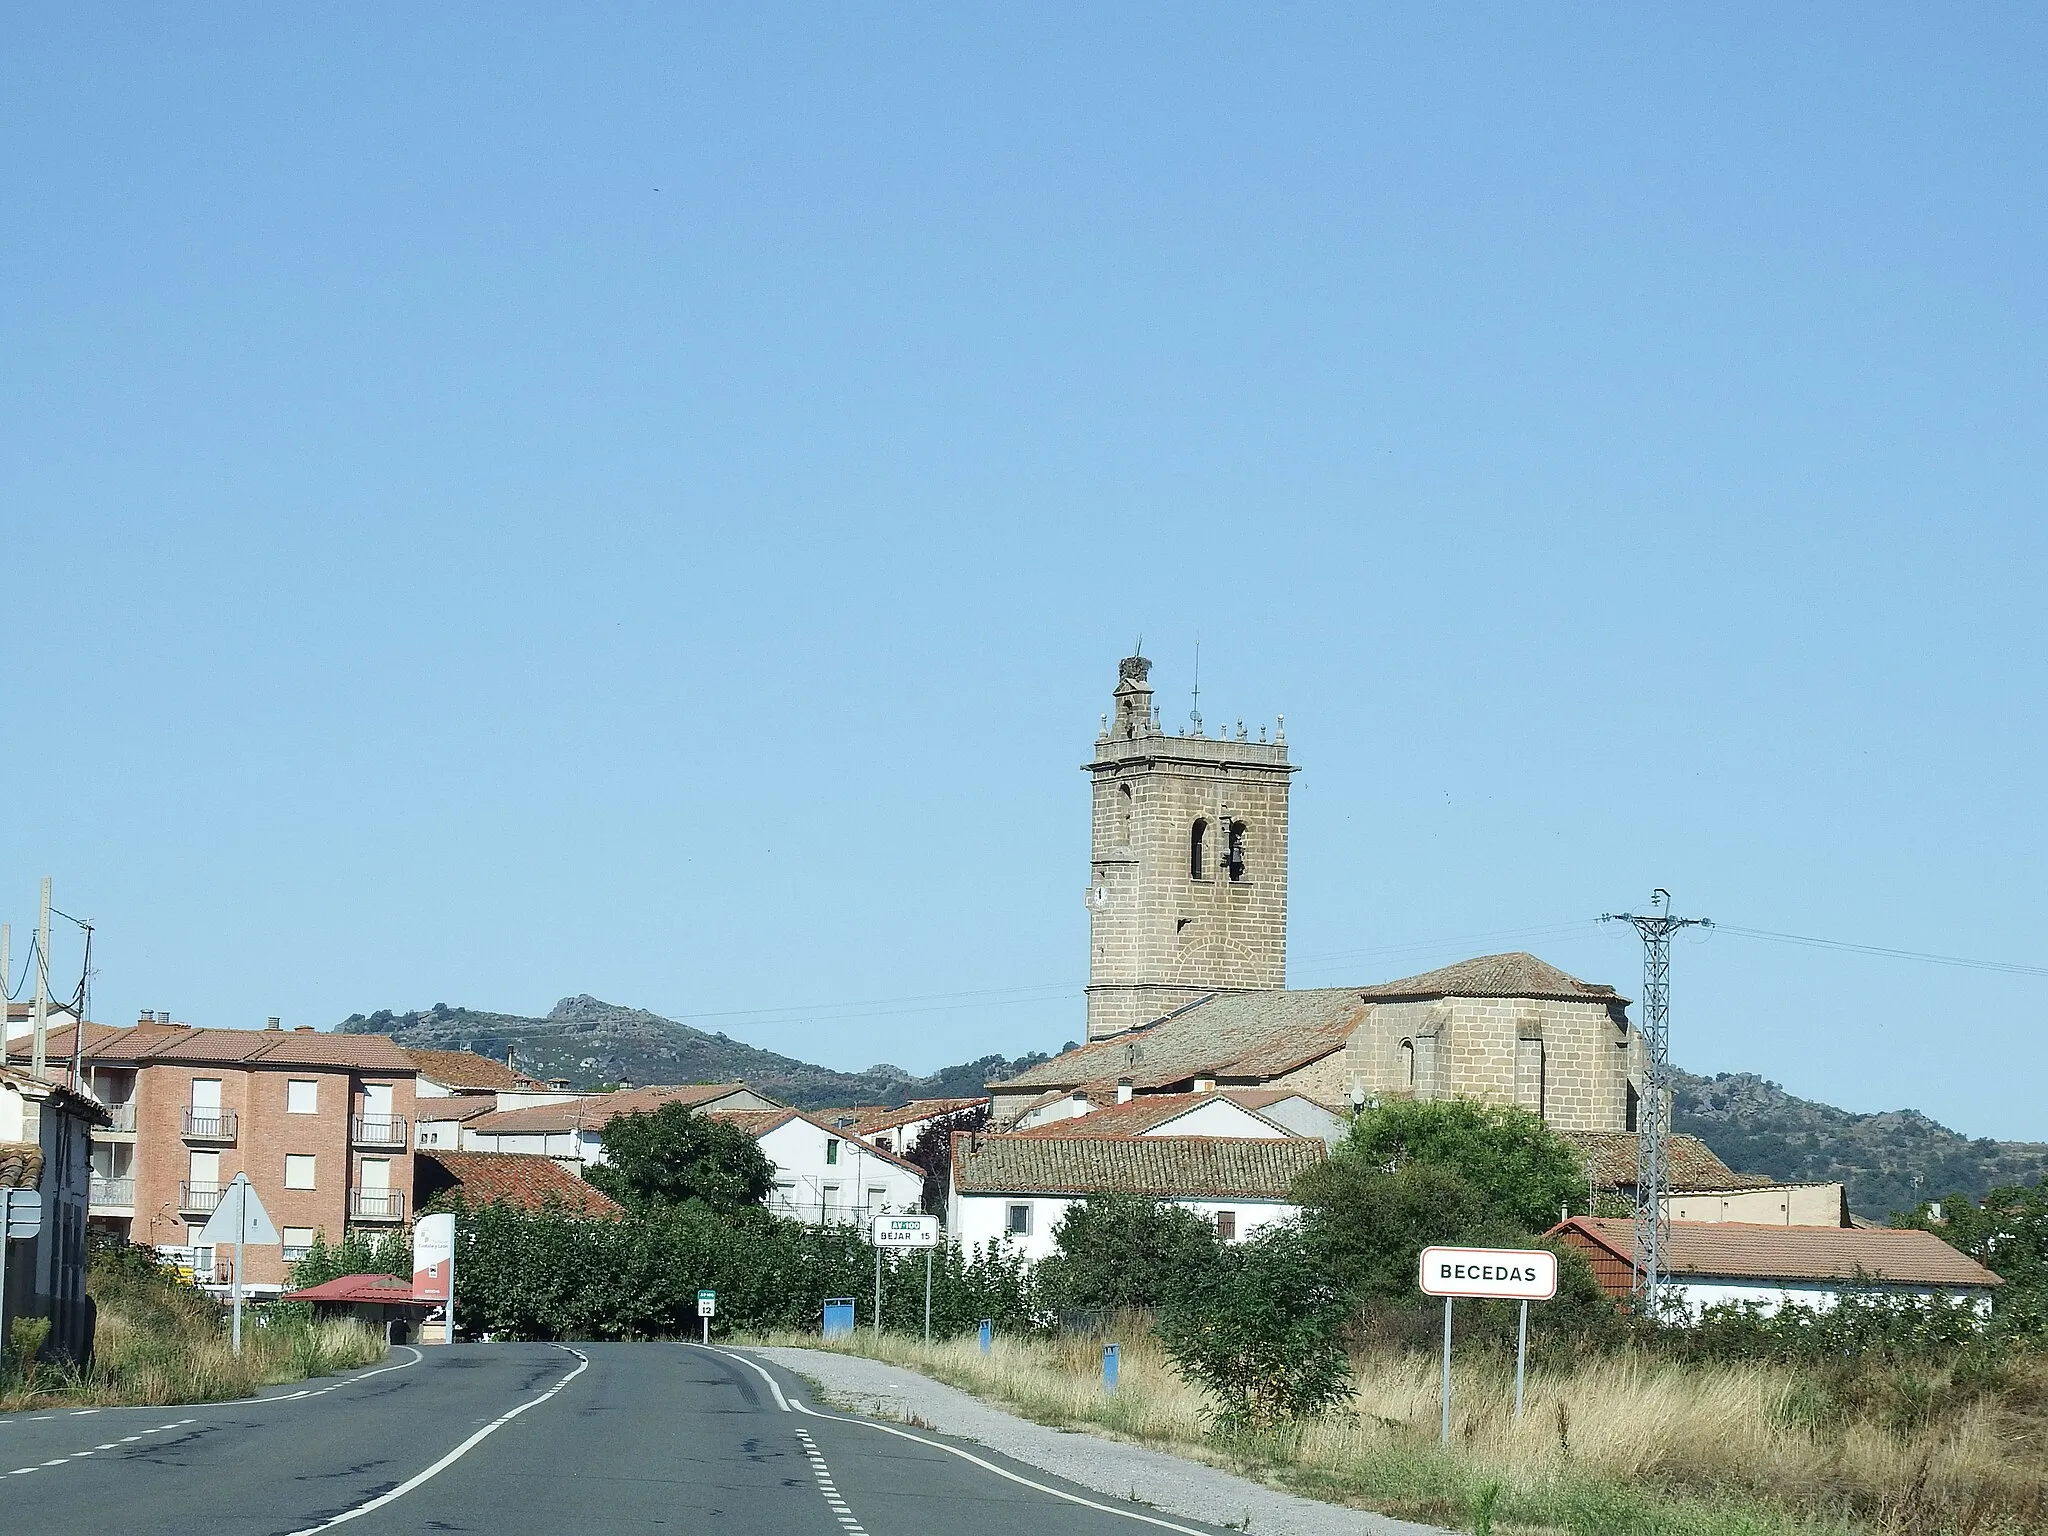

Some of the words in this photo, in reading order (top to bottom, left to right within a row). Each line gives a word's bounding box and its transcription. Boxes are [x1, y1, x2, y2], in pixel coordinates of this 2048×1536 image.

[921, 1232, 931, 1240] 15
[1440, 1264, 1536, 1281] BECEDAS
[702, 1306, 712, 1314] 12
